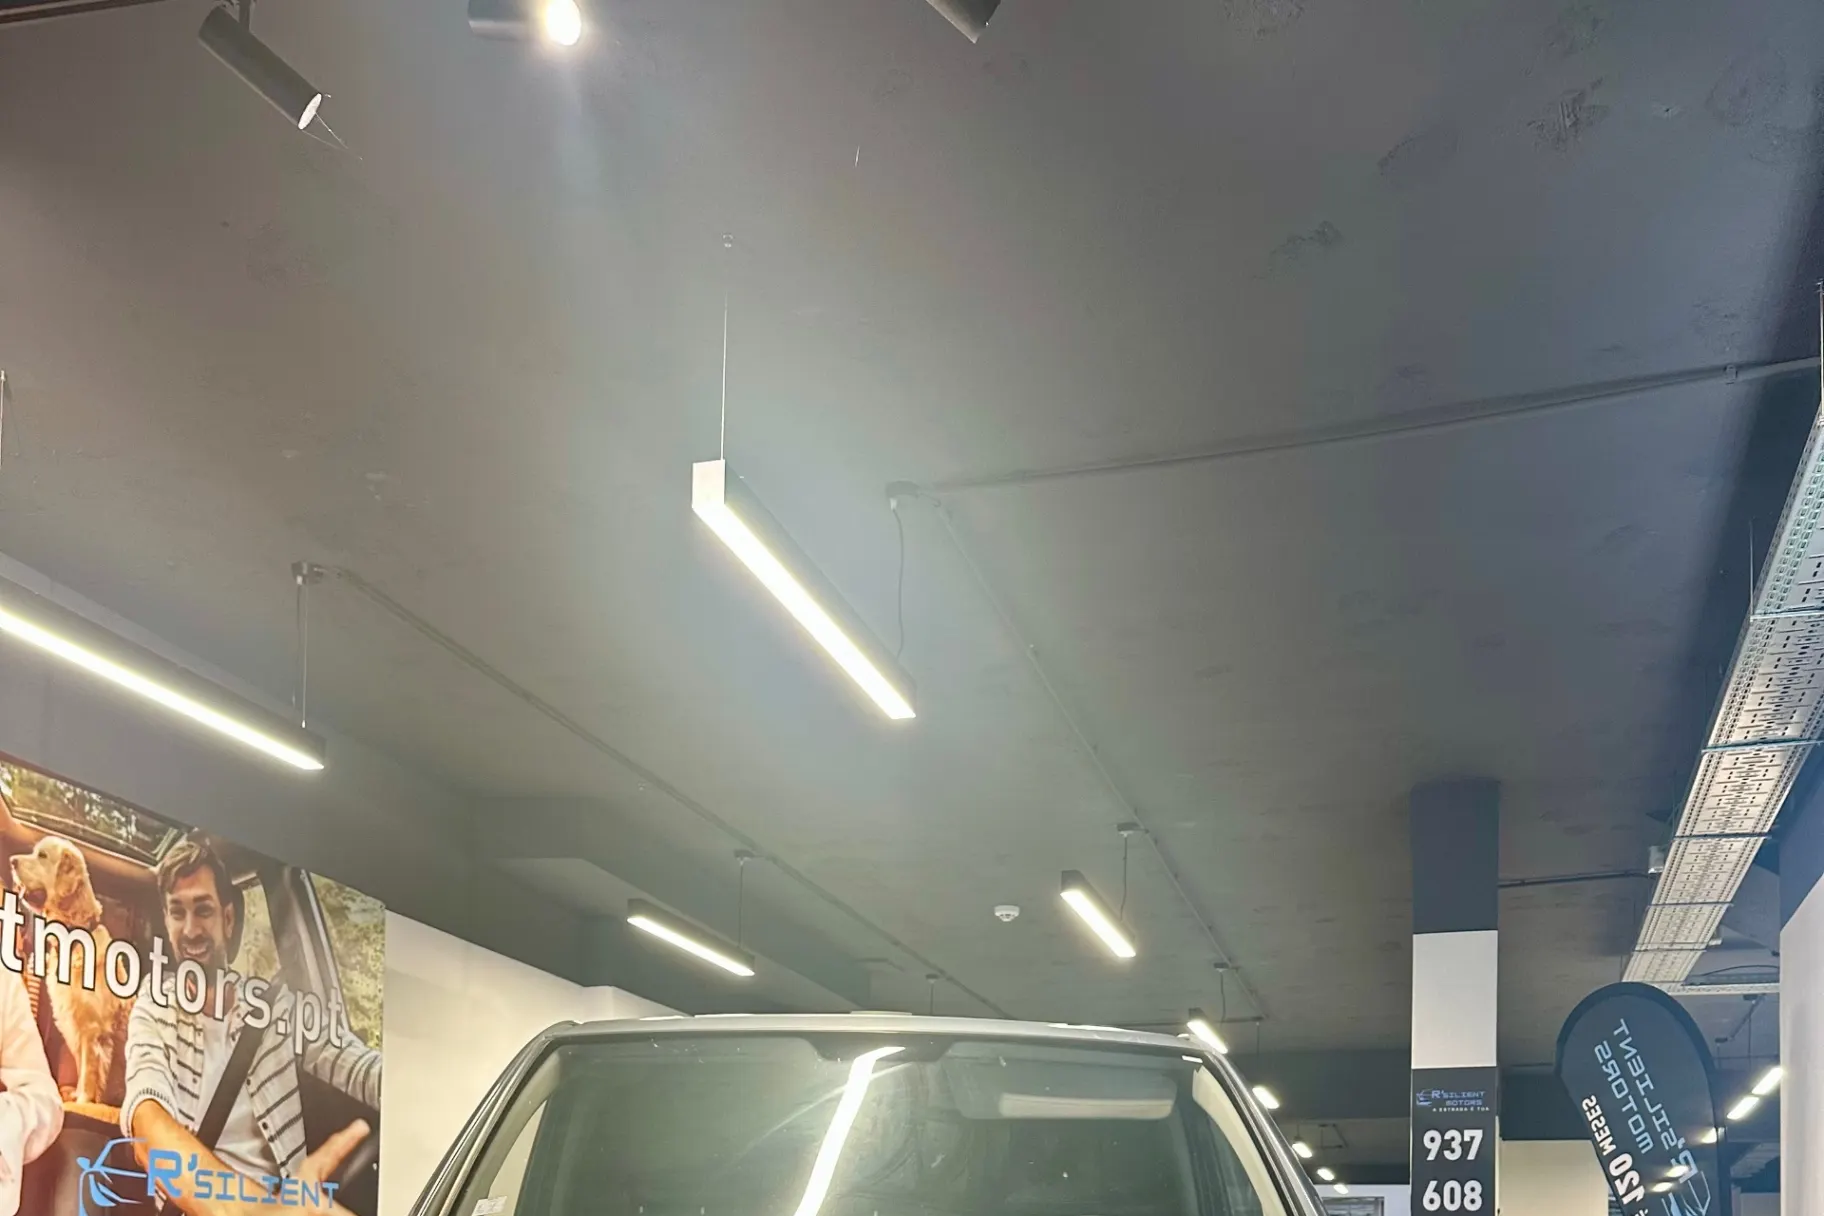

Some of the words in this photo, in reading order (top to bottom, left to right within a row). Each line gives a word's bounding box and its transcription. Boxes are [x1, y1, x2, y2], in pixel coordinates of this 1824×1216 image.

[0, 890, 344, 1055] tmotors.pt
[1423, 1129, 1483, 1161] 937
[147, 1149, 340, 1208] R'SILIENT
[1423, 1180, 1482, 1211] 608
